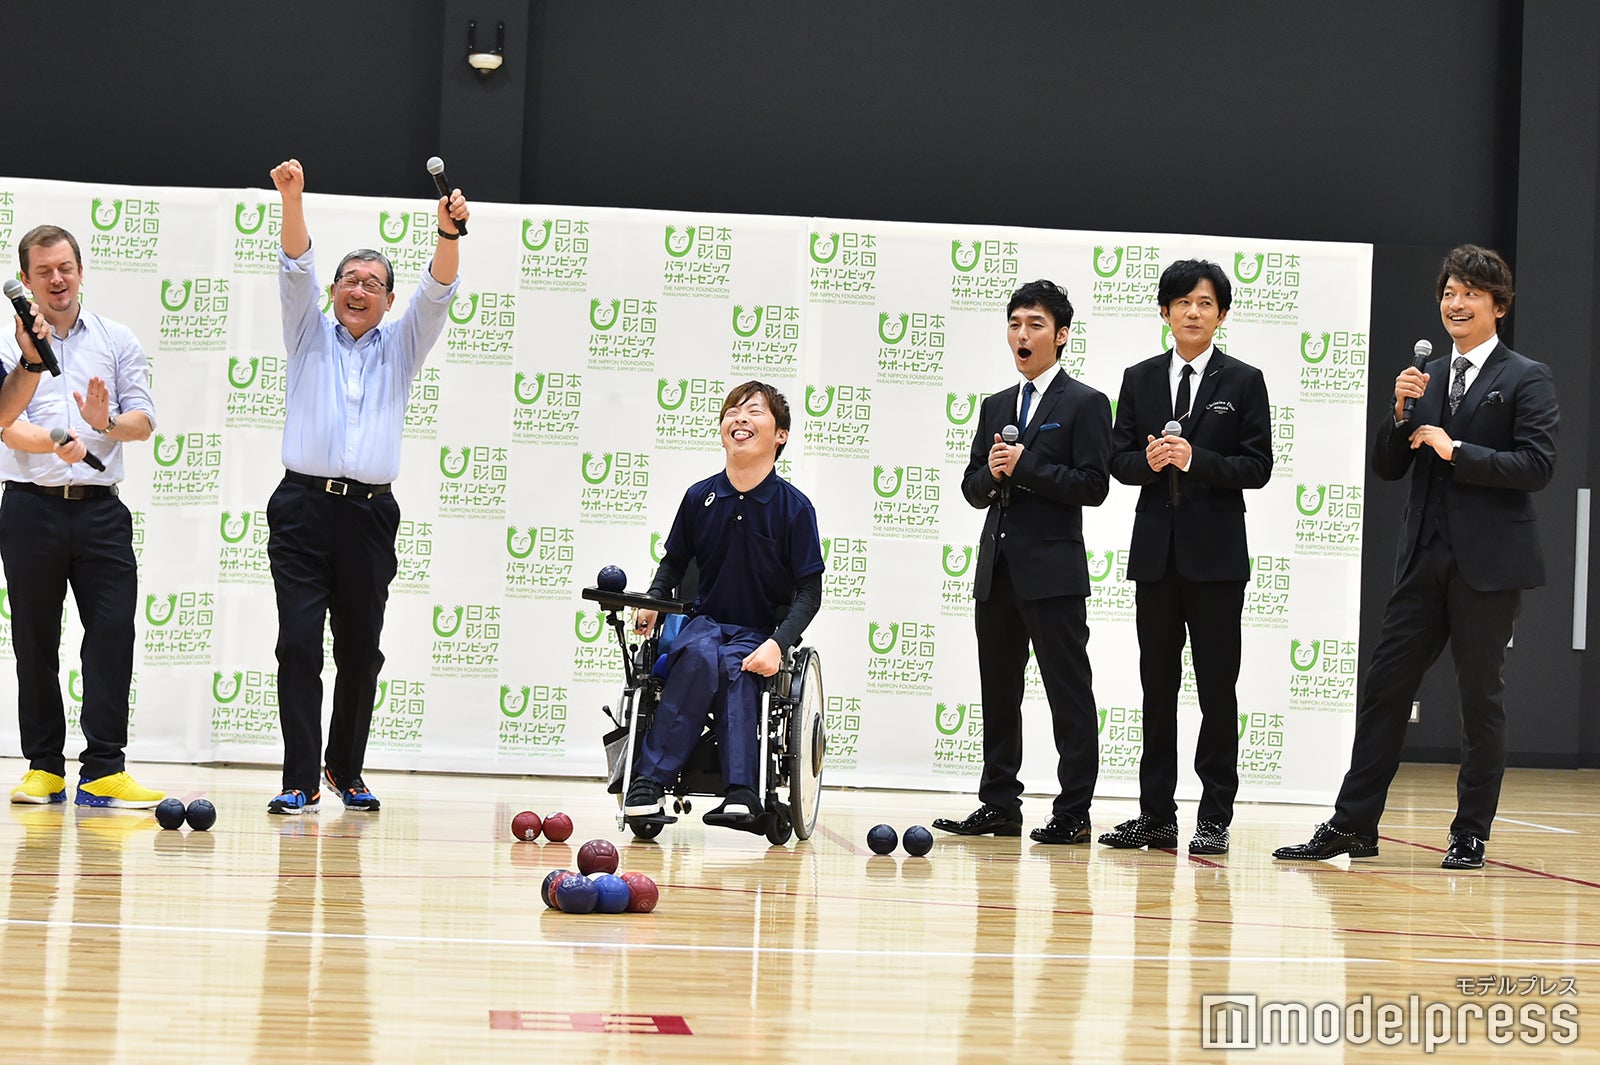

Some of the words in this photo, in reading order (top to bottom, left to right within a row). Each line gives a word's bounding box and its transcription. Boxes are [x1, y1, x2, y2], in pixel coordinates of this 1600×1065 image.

[124, 198, 159, 216] 日本
[124, 216, 160, 235] 財団
[554, 218, 589, 236] 日本
[697, 225, 732, 242] 日本
[91, 234, 159, 248] パラリンピック
[554, 236, 590, 254] 財団
[842, 231, 876, 249] 日本
[984, 239, 1018, 256] 日本
[91, 246, 158, 260] サポートセンター
[697, 242, 733, 261] 財団
[842, 249, 877, 268] 財団
[1125, 244, 1160, 262] 日本
[522, 254, 588, 267] パラリンピック
[664, 260, 731, 274] パラリンピック
[984, 257, 1019, 275] 財団
[1266, 252, 1300, 269] 日本
[521, 266, 587, 279] サポートセンター
[664, 272, 730, 286] サポートセンター
[810, 267, 876, 281] パラリンピック
[1125, 262, 1161, 280] 財団
[1266, 269, 1301, 288] 財団
[194, 277, 229, 295] 日本
[810, 279, 876, 292] サポートセンター
[952, 275, 1018, 288] パラリンピック
[1093, 281, 1159, 293] パラリンピック
[481, 292, 515, 309] 日本
[1093, 293, 1158, 305] サポートセンター
[1234, 287, 1300, 300] パラリンピック
[193, 295, 229, 313] 財団
[622, 298, 657, 315] 日本
[1234, 299, 1299, 312] サポートセンター
[160, 314, 228, 327] パラリンピック
[480, 309, 516, 328] 財団
[765, 304, 799, 322] 日本
[911, 312, 945, 329] 日本
[160, 326, 227, 339] サポートセンター
[622, 316, 657, 334] 財団
[764, 322, 800, 340] 財団
[448, 328, 514, 341] パラリンピック
[589, 334, 656, 347] パラリンピック
[910, 330, 946, 348] 財団
[1332, 330, 1366, 348] 日本
[447, 340, 513, 353] サポートセンター
[589, 346, 655, 359] サポートセンター
[732, 340, 799, 353] パラリンピック
[878, 347, 945, 361] パラリンピック
[732, 352, 798, 365] サポートセンター
[1332, 348, 1367, 366] 財団
[878, 359, 944, 373] サポートセンター
[1301, 366, 1366, 379] パラリンピック
[547, 372, 581, 389] 日本
[690, 378, 724, 395] 日本
[1301, 379, 1365, 391] サポートセンター
[546, 389, 582, 408] 財団
[837, 385, 871, 402] 日本
[689, 395, 725, 414] 財団
[836, 402, 872, 421] 財団
[514, 408, 580, 421] パラリンピック
[657, 414, 720, 427] パラリンピック
[513, 420, 579, 433] サポートセンター
[804, 420, 870, 434] パラリンピック
[187, 432, 221, 450] 日本
[804, 432, 869, 446] サポートセンター
[186, 450, 222, 468] 財団
[472, 445, 507, 463] 日本
[614, 451, 649, 469] 日本
[153, 469, 220, 482] パラリンピック
[472, 463, 508, 482] 財団
[614, 469, 650, 488] 財団
[906, 465, 940, 483] 日本
[153, 481, 219, 493] サポートセンター
[440, 482, 507, 495] パラリンピック
[581, 487, 648, 501] パラリンピック
[906, 483, 941, 502] 財団
[1328, 483, 1361, 501] 日本
[439, 494, 506, 507] サポートセンター
[581, 500, 647, 513] サポートセンター
[874, 501, 940, 514] パラリンピック
[1328, 501, 1362, 519] 財団
[874, 513, 939, 526] サポートセンター
[1296, 519, 1361, 532] パラリンピック
[399, 520, 433, 537] 日本
[539, 526, 574, 543] 日本
[1296, 531, 1360, 544] サポートセンター
[398, 539, 432, 555] 財団
[539, 544, 575, 562] 財団
[834, 538, 867, 554] 日本
[506, 562, 573, 576] パラリンピック
[833, 556, 867, 572] 財団
[1257, 556, 1290, 572] 日本
[506, 574, 572, 588] サポートセンター
[1257, 574, 1290, 590] 財団
[179, 591, 214, 609] 日本
[178, 609, 214, 627] 財団
[465, 604, 500, 622] 日本
[145, 628, 213, 641] パラリンピック
[465, 622, 501, 640] 財団
[901, 621, 935, 639] 日本
[144, 640, 211, 653] サポートセンター
[432, 641, 500, 654] パラリンピック
[900, 639, 936, 658] 財団
[1322, 639, 1356, 656] 日本
[432, 653, 498, 666] サポートセンター
[868, 657, 935, 671] パラリンピック
[1322, 656, 1357, 675] 財団
[245, 670, 278, 688] 日本
[868, 669, 934, 683] サポートセンター
[1290, 674, 1356, 688] パラリンピック
[391, 680, 425, 696] 日本
[532, 685, 567, 702] 日本
[1290, 686, 1355, 700] サポートセンター
[244, 688, 279, 707] 財団
[827, 696, 861, 712] 日本
[212, 707, 278, 720] パラリンピック
[390, 698, 424, 714] 財団
[532, 703, 568, 721] 財団
[826, 715, 860, 731] 財団
[1110, 707, 1143, 724] 日本
[1251, 712, 1284, 729] 日本
[211, 719, 277, 733] サポートセンター
[499, 721, 567, 734] パラリンピック
[1109, 726, 1143, 742] 財団
[499, 733, 565, 746] サポートセンター
[1250, 731, 1283, 747] 財団
